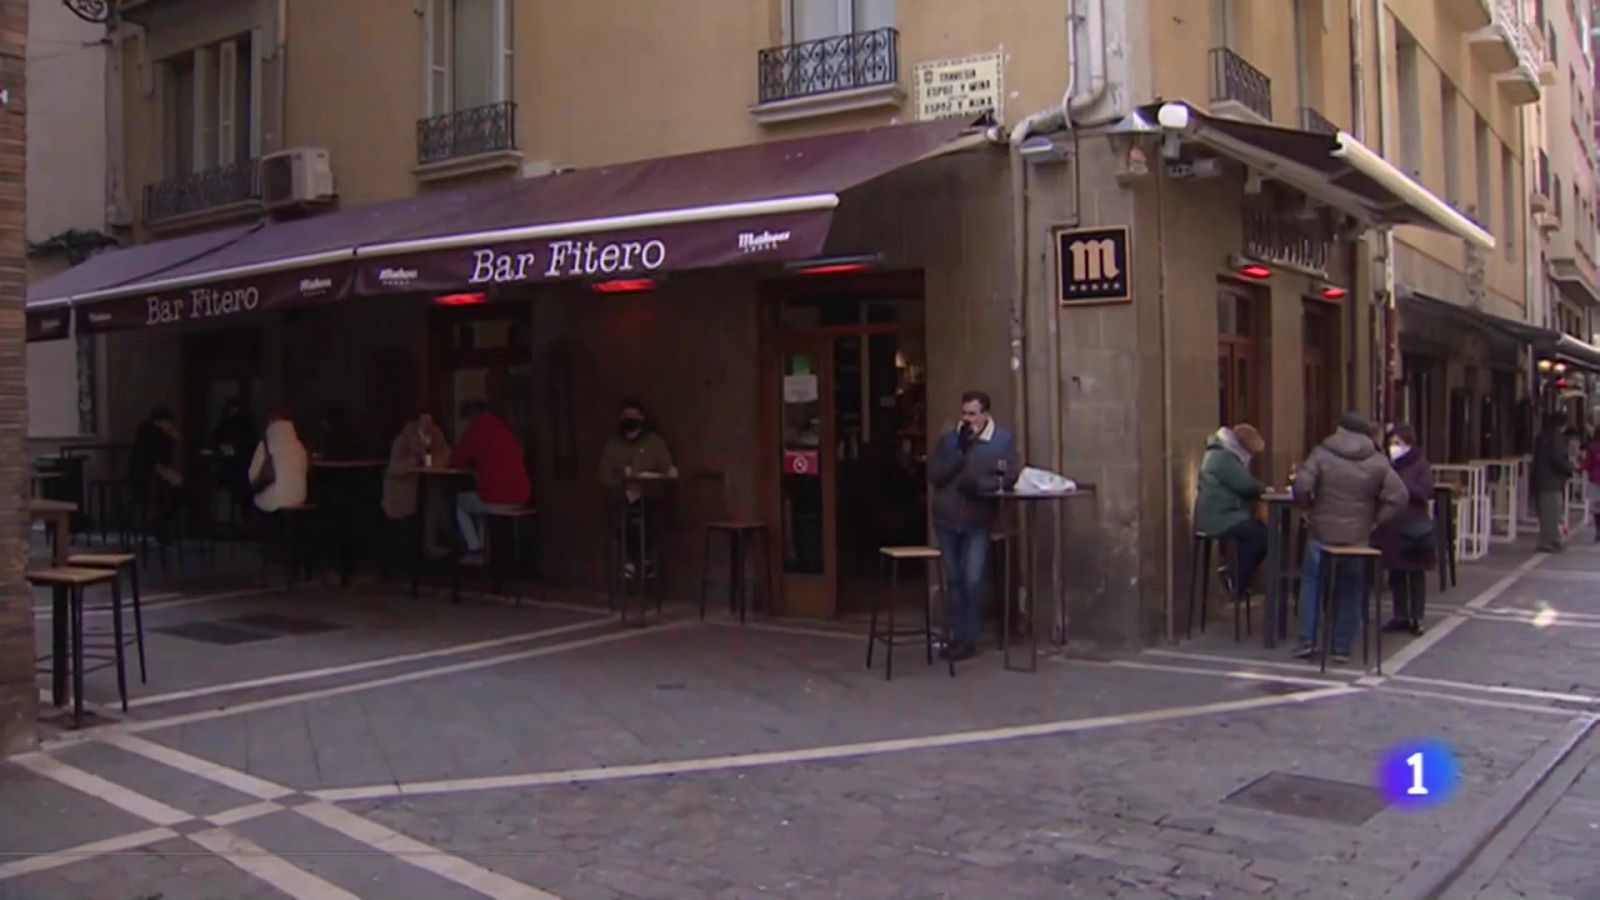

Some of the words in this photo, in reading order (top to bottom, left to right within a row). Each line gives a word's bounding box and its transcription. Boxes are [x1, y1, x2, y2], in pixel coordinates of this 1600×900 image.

[468, 248, 535, 284] Bar
[544, 239, 666, 277] Fitero
[145, 296, 184, 326] Bar
[189, 286, 259, 319] Fitero
